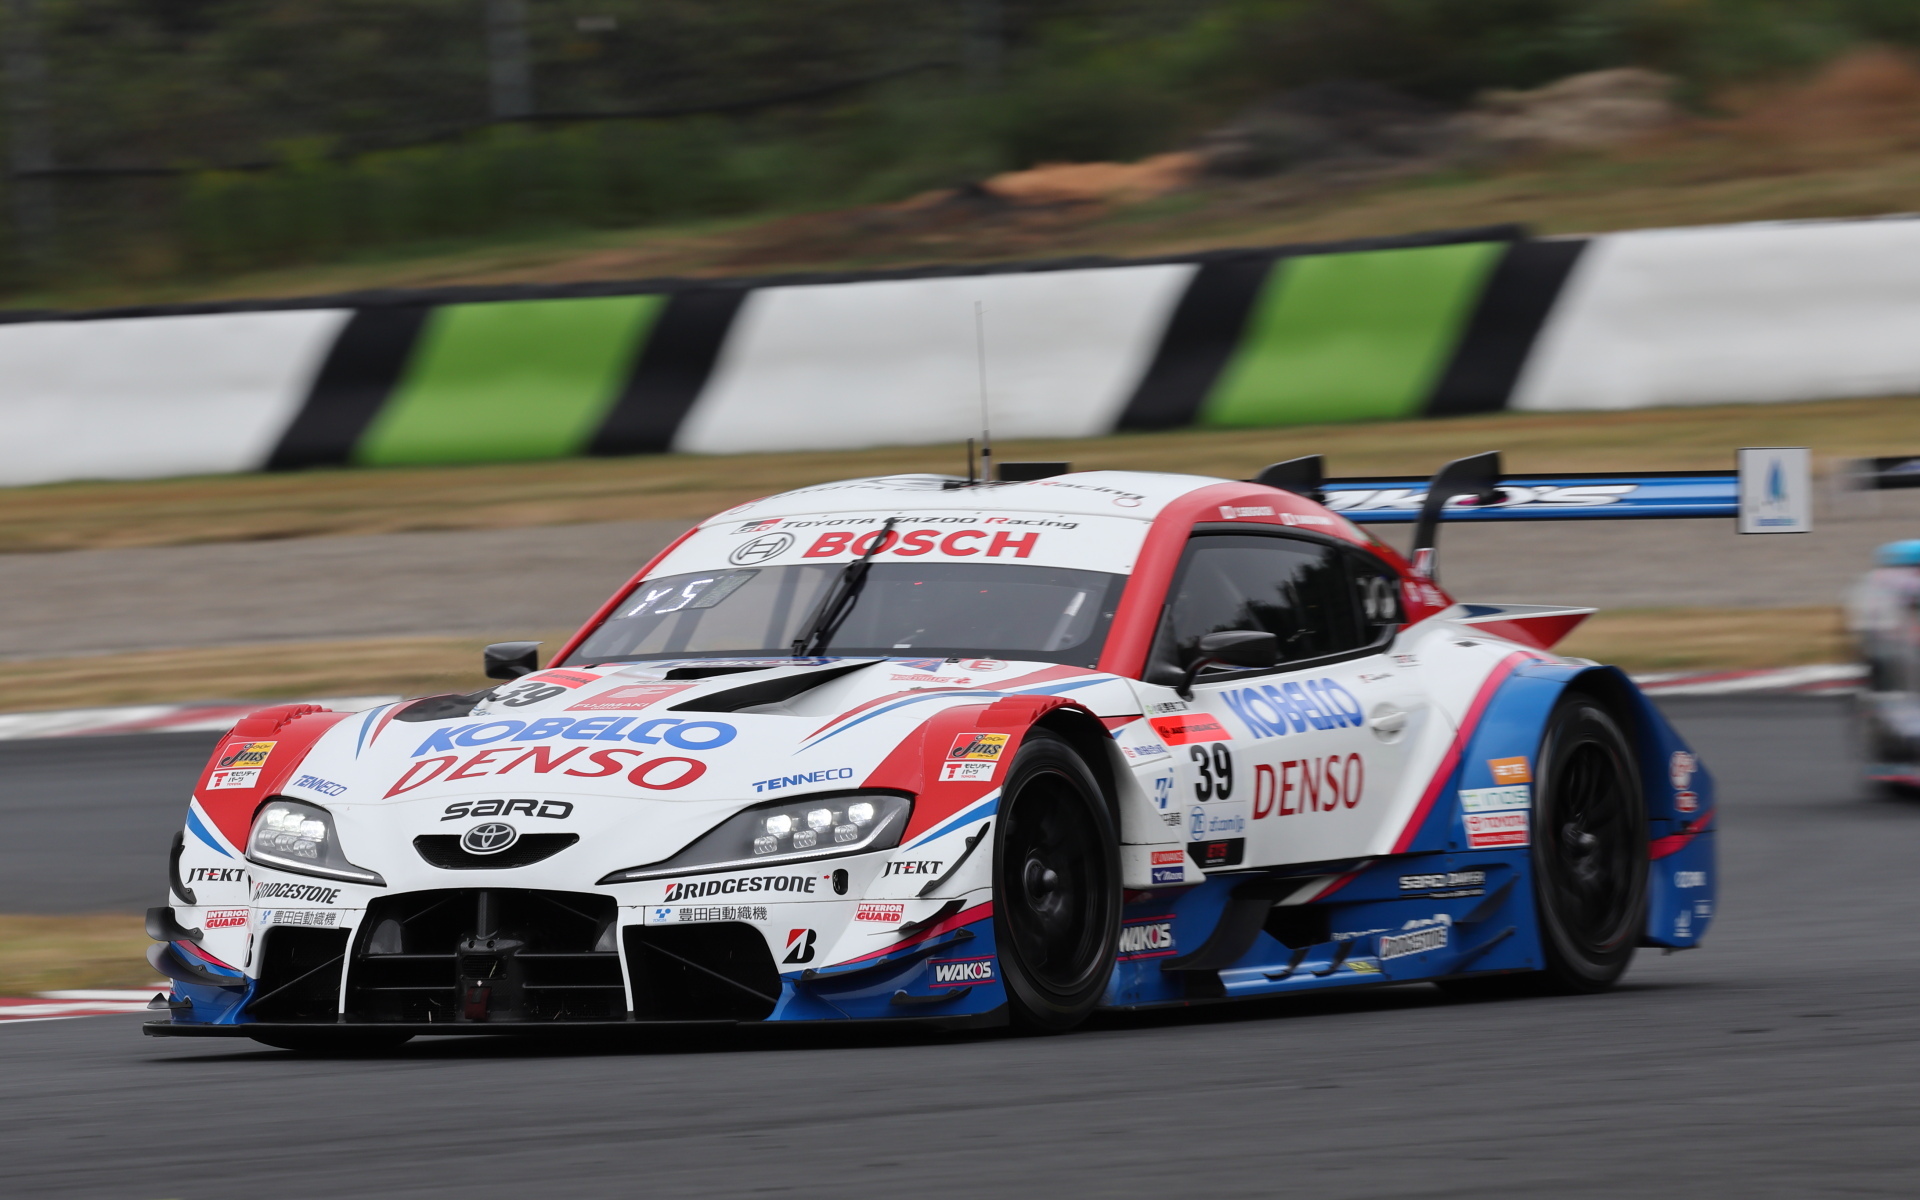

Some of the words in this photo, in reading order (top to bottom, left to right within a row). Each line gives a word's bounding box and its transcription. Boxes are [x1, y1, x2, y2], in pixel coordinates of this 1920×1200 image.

[781, 518, 876, 529] TOYOTA
[984, 517, 1079, 530] Racing
[801, 529, 1041, 558] BOSCH
[1218, 678, 1365, 739] KOBELCO
[410, 716, 737, 758] KOBELCO
[382, 746, 707, 800] DENSO
[752, 767, 853, 793] TENNECO
[1190, 742, 1233, 802] 39
[293, 774, 347, 797] TENNECO
[1251, 752, 1364, 820] DENSO
[185, 868, 246, 884] JTEKT
[881, 861, 943, 878] JTEKT
[252, 882, 341, 904] BRIDGESTONE
[663, 876, 817, 903] BRIDGESTONE
[207, 910, 249, 918] INTERIOR
[272, 910, 337, 925] 豊田自動織機
[679, 906, 768, 921] 豊田自動織機
[856, 912, 901, 923] GUARD
[858, 903, 903, 914] INTERIOR
[206, 917, 246, 928] GUARD
